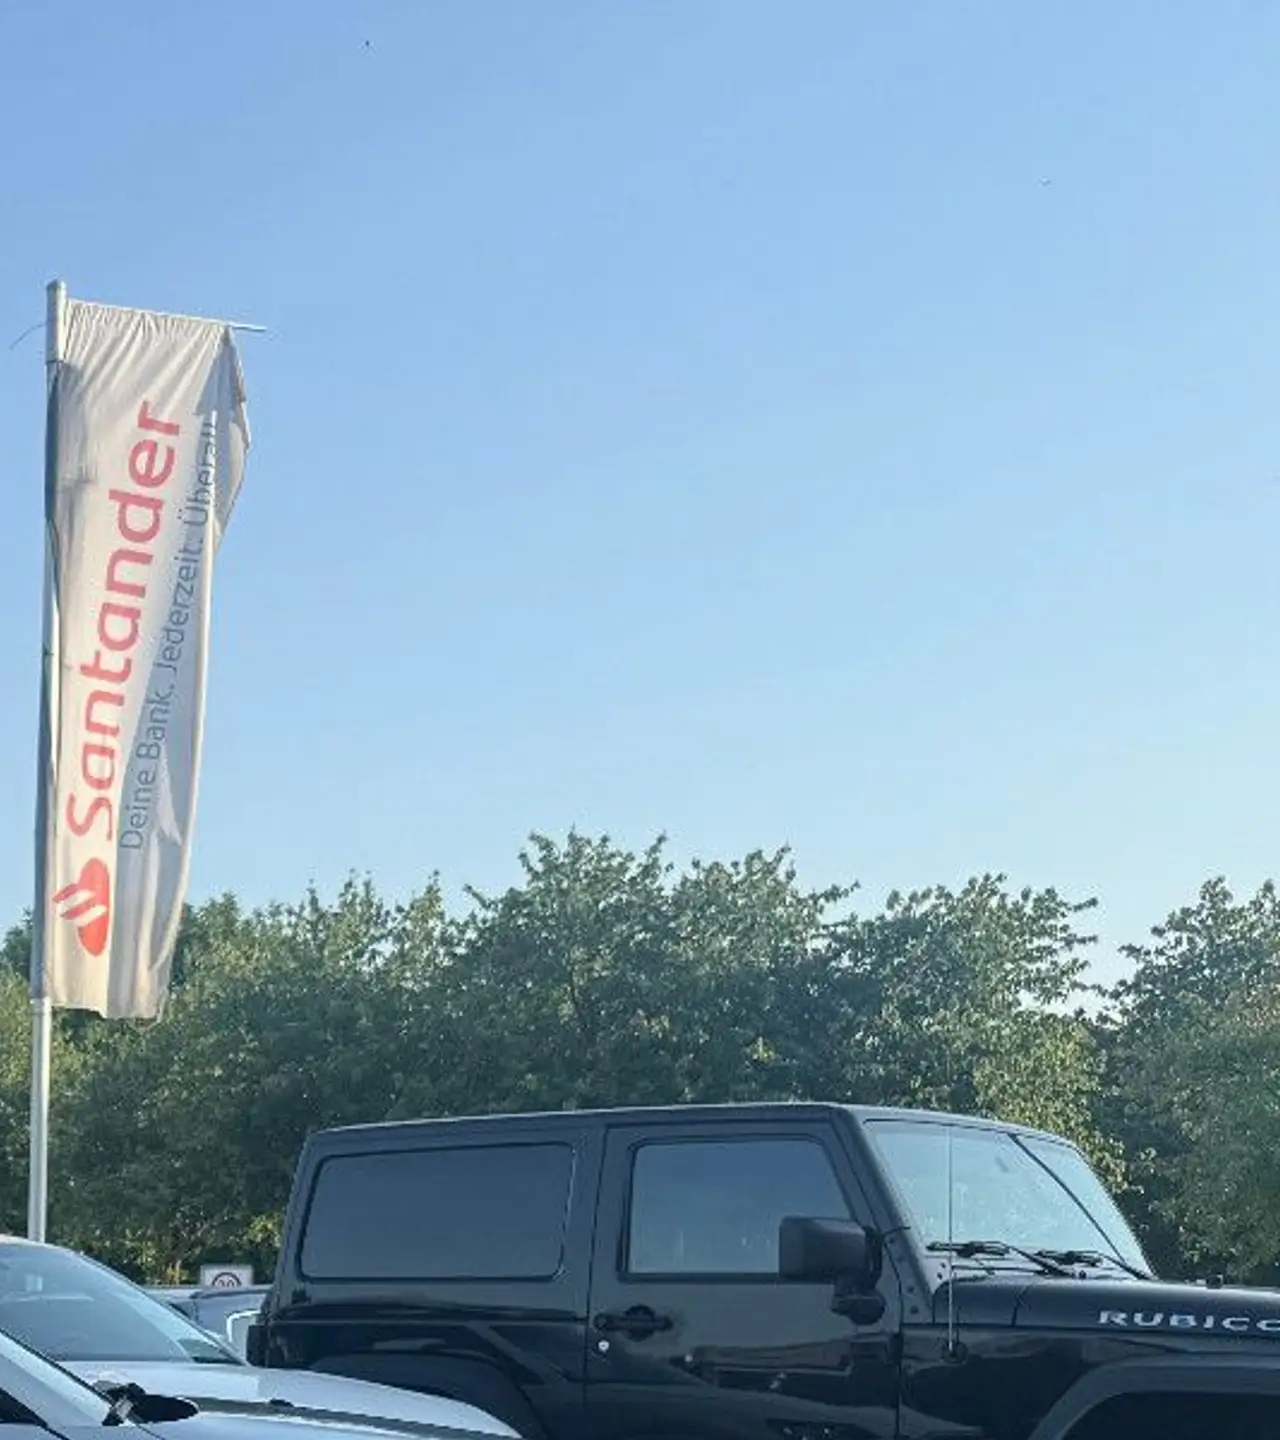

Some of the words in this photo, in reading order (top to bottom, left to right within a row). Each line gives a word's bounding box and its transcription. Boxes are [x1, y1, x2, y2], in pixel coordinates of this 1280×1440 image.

[66, 400, 181, 841] Santander
[153, 538, 204, 675] Jederzeit.
[135, 684, 176, 760] Bank.
[119, 770, 156, 849] Deine
